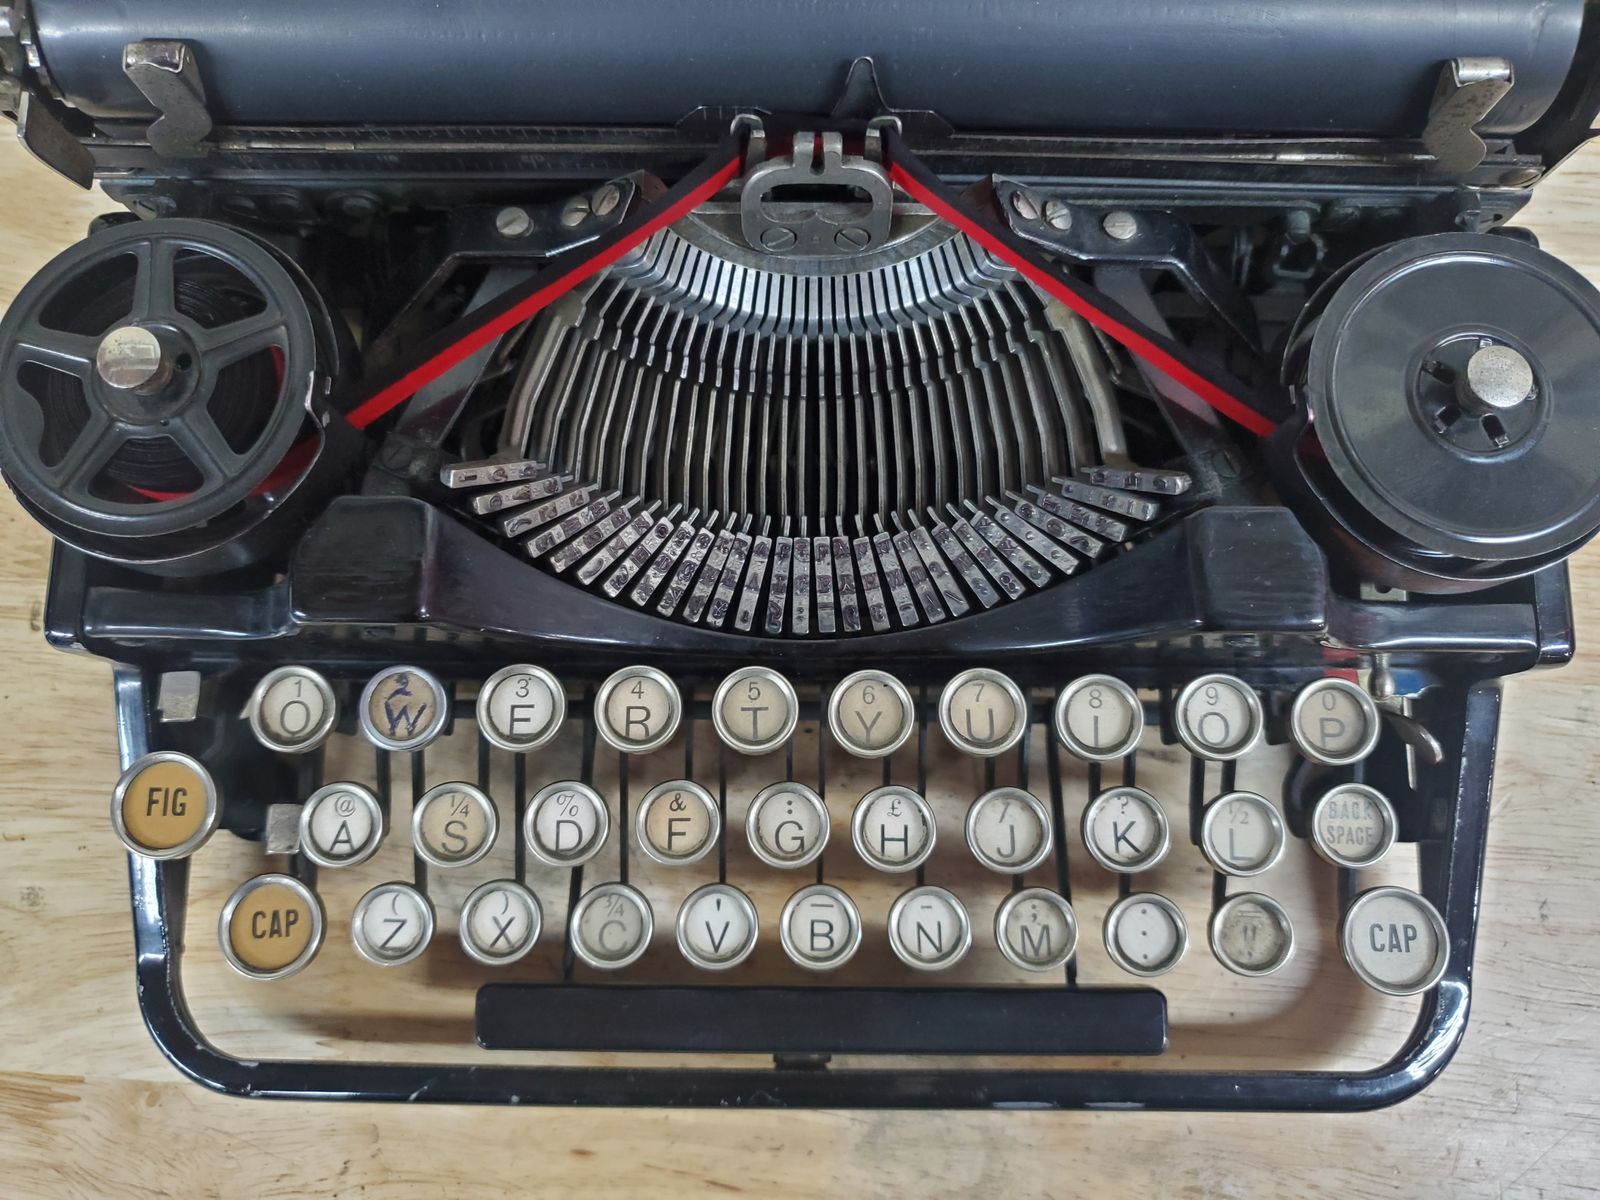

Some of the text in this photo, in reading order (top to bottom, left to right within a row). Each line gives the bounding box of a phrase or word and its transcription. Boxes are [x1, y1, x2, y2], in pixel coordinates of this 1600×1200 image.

[295, 679, 302, 697] 1
[516, 678, 531, 698] 3
[631, 680, 645, 699] 4
[748, 682, 760, 701] 5
[862, 685, 875, 704] 6
[973, 683, 984, 702] 7
[1089, 689, 1102, 708] 8
[1205, 687, 1218, 705] 9
[384, 701, 427, 736] W
[625, 706, 651, 738] R
[741, 706, 769, 739] T
[854, 710, 882, 744] Y
[965, 709, 995, 741] U
[1198, 712, 1229, 746] O
[1319, 717, 1346, 749] P
[146, 787, 188, 816] FIG
[334, 795, 356, 817] @
[556, 794, 579, 817] %
[670, 793, 686, 811] &
[887, 799, 902, 817] £
[1119, 796, 1129, 814] ?
[1328, 801, 1373, 820] BACK
[329, 820, 355, 852] A
[441, 820, 468, 854] S
[555, 820, 583, 851] D
[667, 818, 691, 850] F
[775, 820, 805, 854] G
[880, 824, 908, 856] H
[997, 825, 1015, 858] J
[1112, 821, 1142, 854] K
[1229, 828, 1254, 860] L
[1327, 825, 1376, 847] SPACE
[251, 909, 299, 939] CAP
[380, 918, 407, 949] Z
[490, 916, 516, 948] X
[598, 920, 628, 951] C
[705, 921, 730, 953] V
[810, 919, 835, 951] B
[916, 921, 943, 953] N
[1369, 923, 1418, 953] CAP
[1020, 924, 1051, 957] M
